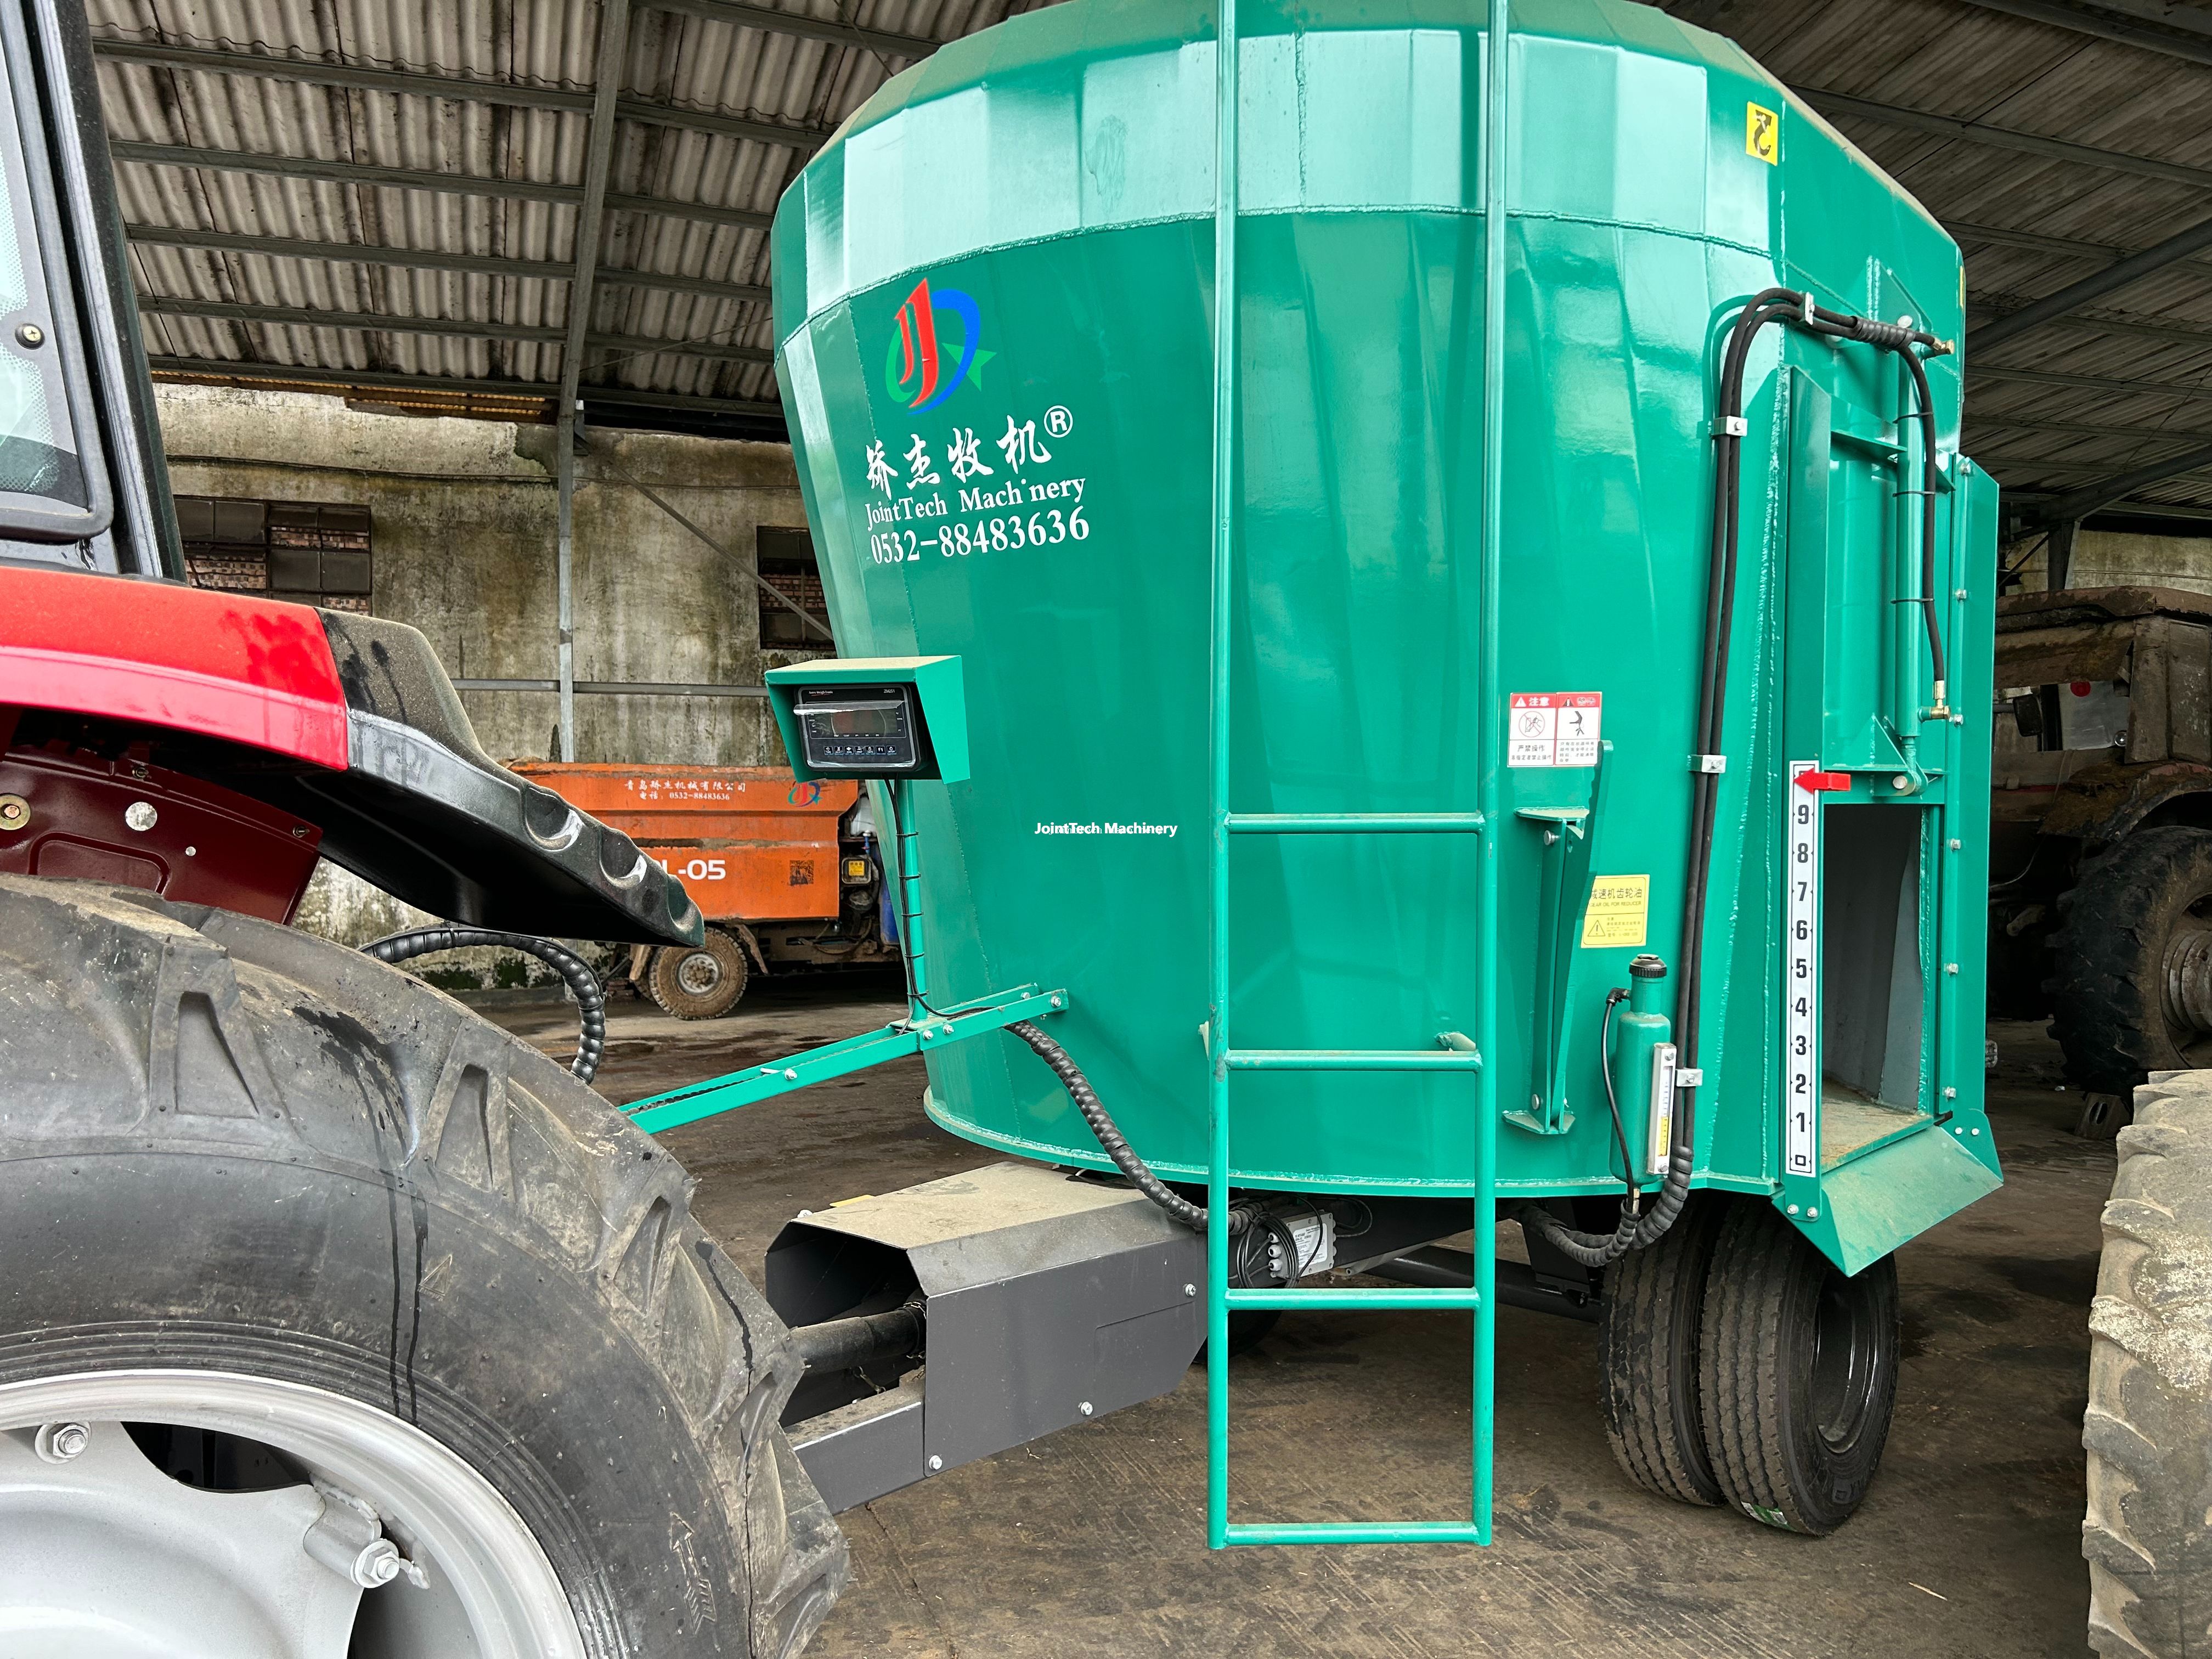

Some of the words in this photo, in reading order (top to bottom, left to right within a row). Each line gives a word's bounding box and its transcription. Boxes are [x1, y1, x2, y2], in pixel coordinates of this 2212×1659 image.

[865, 494, 948, 531] JointTech
[959, 478, 1086, 514] Machnery
[870, 505, 1090, 565] 0532-88483636
[1529, 697, 1549, 707] 注意
[669, 792, 730, 800] 0532-88483636
[1798, 804, 1809, 825] 9
[1798, 843, 1808, 863] 8
[1798, 881, 1807, 901] 7
[1796, 920, 1808, 940] 6
[1796, 958, 1807, 979] 5
[1796, 997, 1807, 1017] 4
[1796, 1035, 1807, 1056] 3
[1796, 1073, 1806, 1094] 2
[1796, 1113, 1805, 1132] 1
